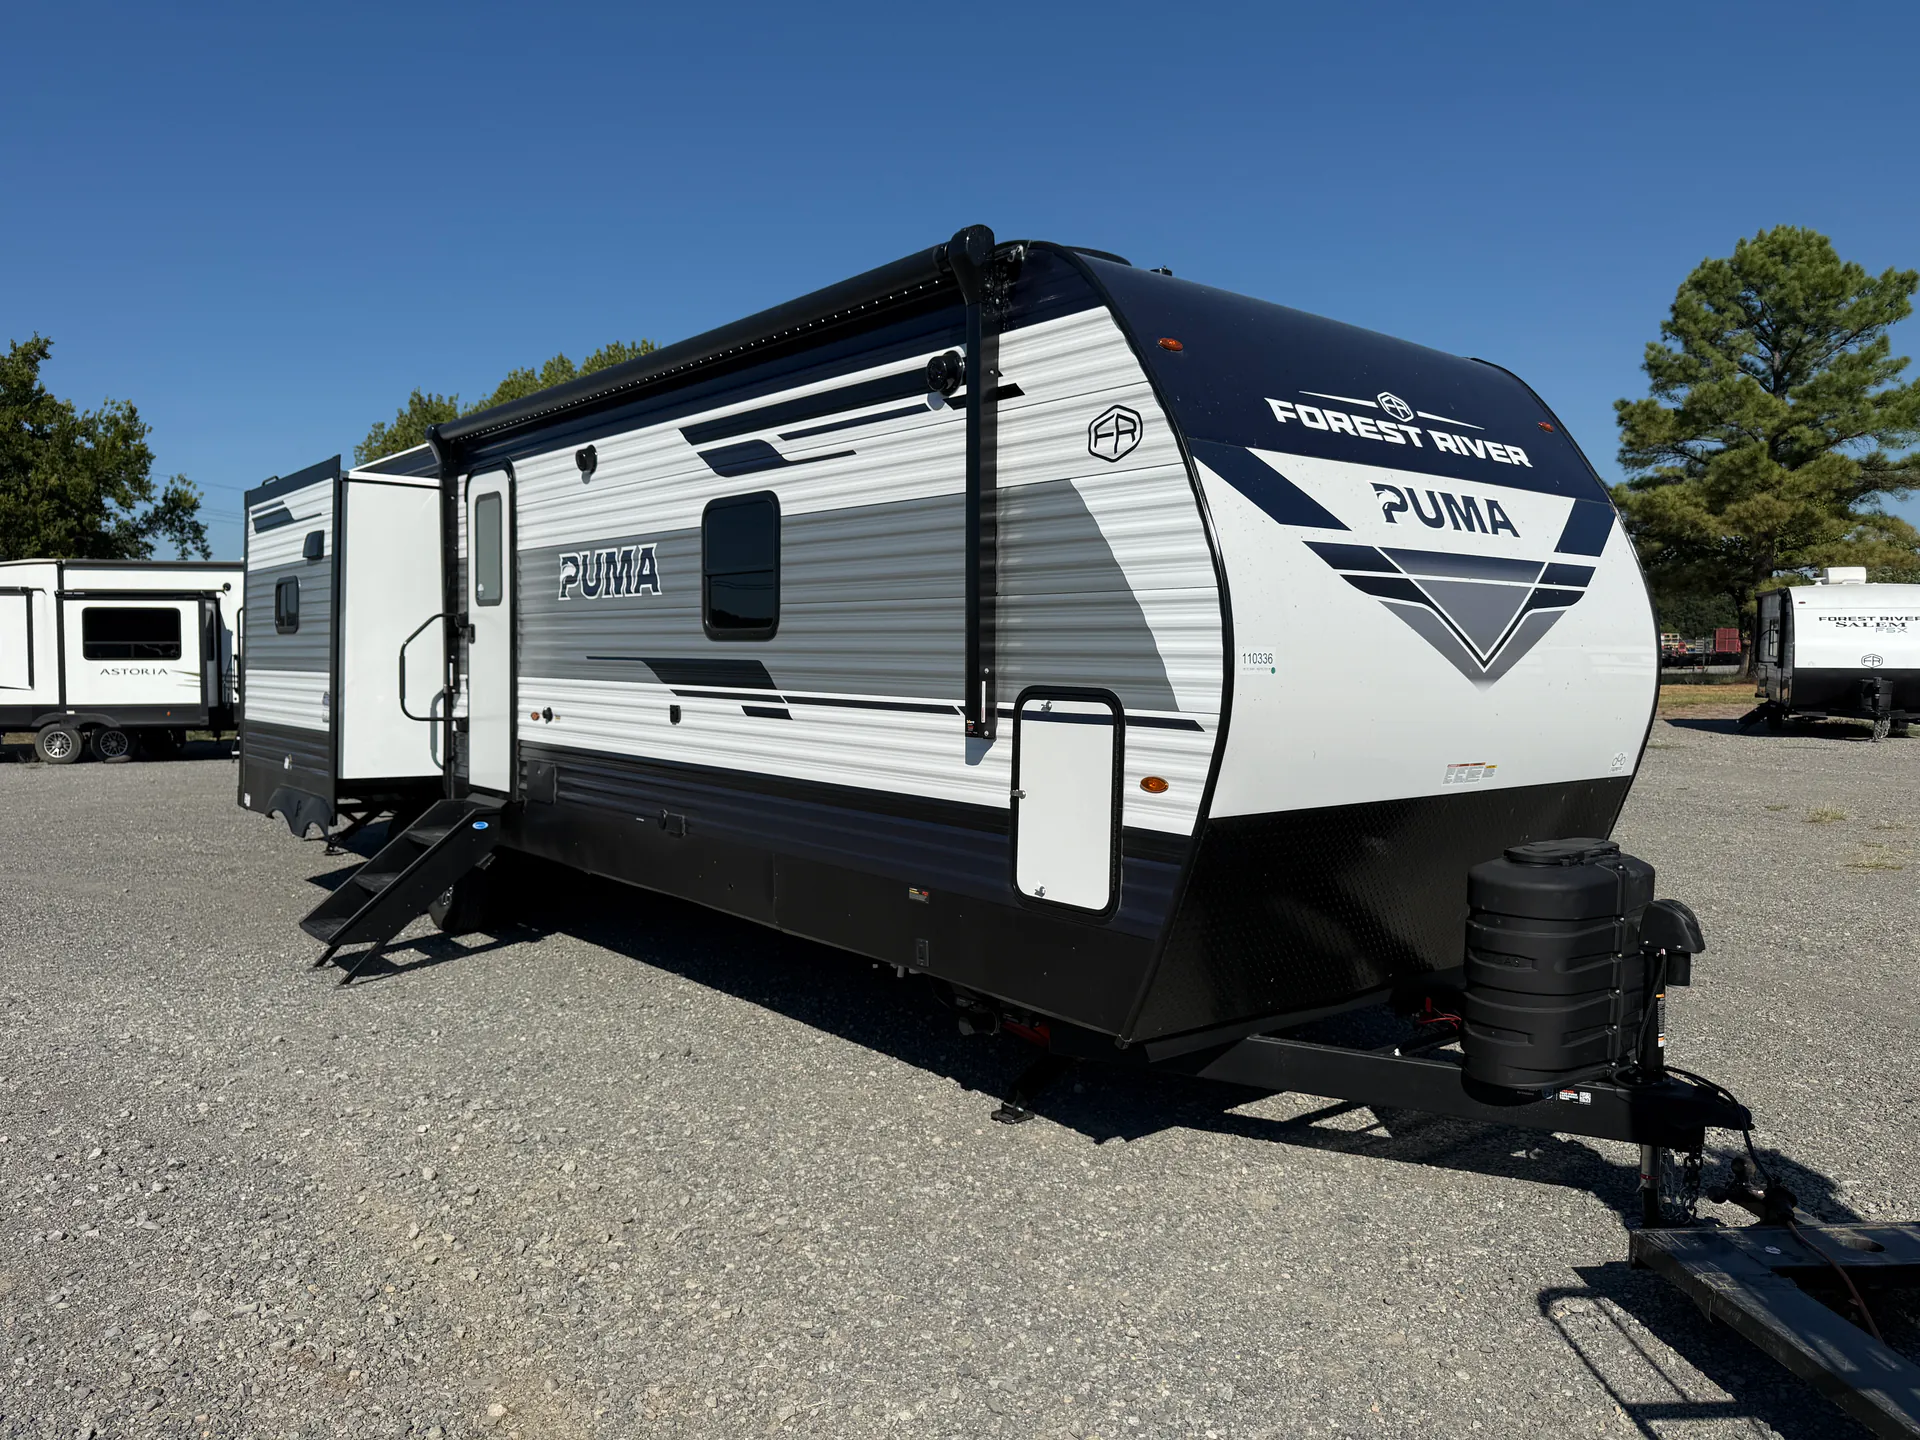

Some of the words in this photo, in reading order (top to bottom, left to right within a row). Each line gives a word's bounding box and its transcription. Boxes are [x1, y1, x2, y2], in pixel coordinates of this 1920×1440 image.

[1263, 396, 1423, 448] FOREST
[1427, 429, 1534, 468] RIVER
[1368, 480, 1522, 539] PUMA
[557, 542, 663, 601] PUMA
[1242, 652, 1274, 664] 110336
